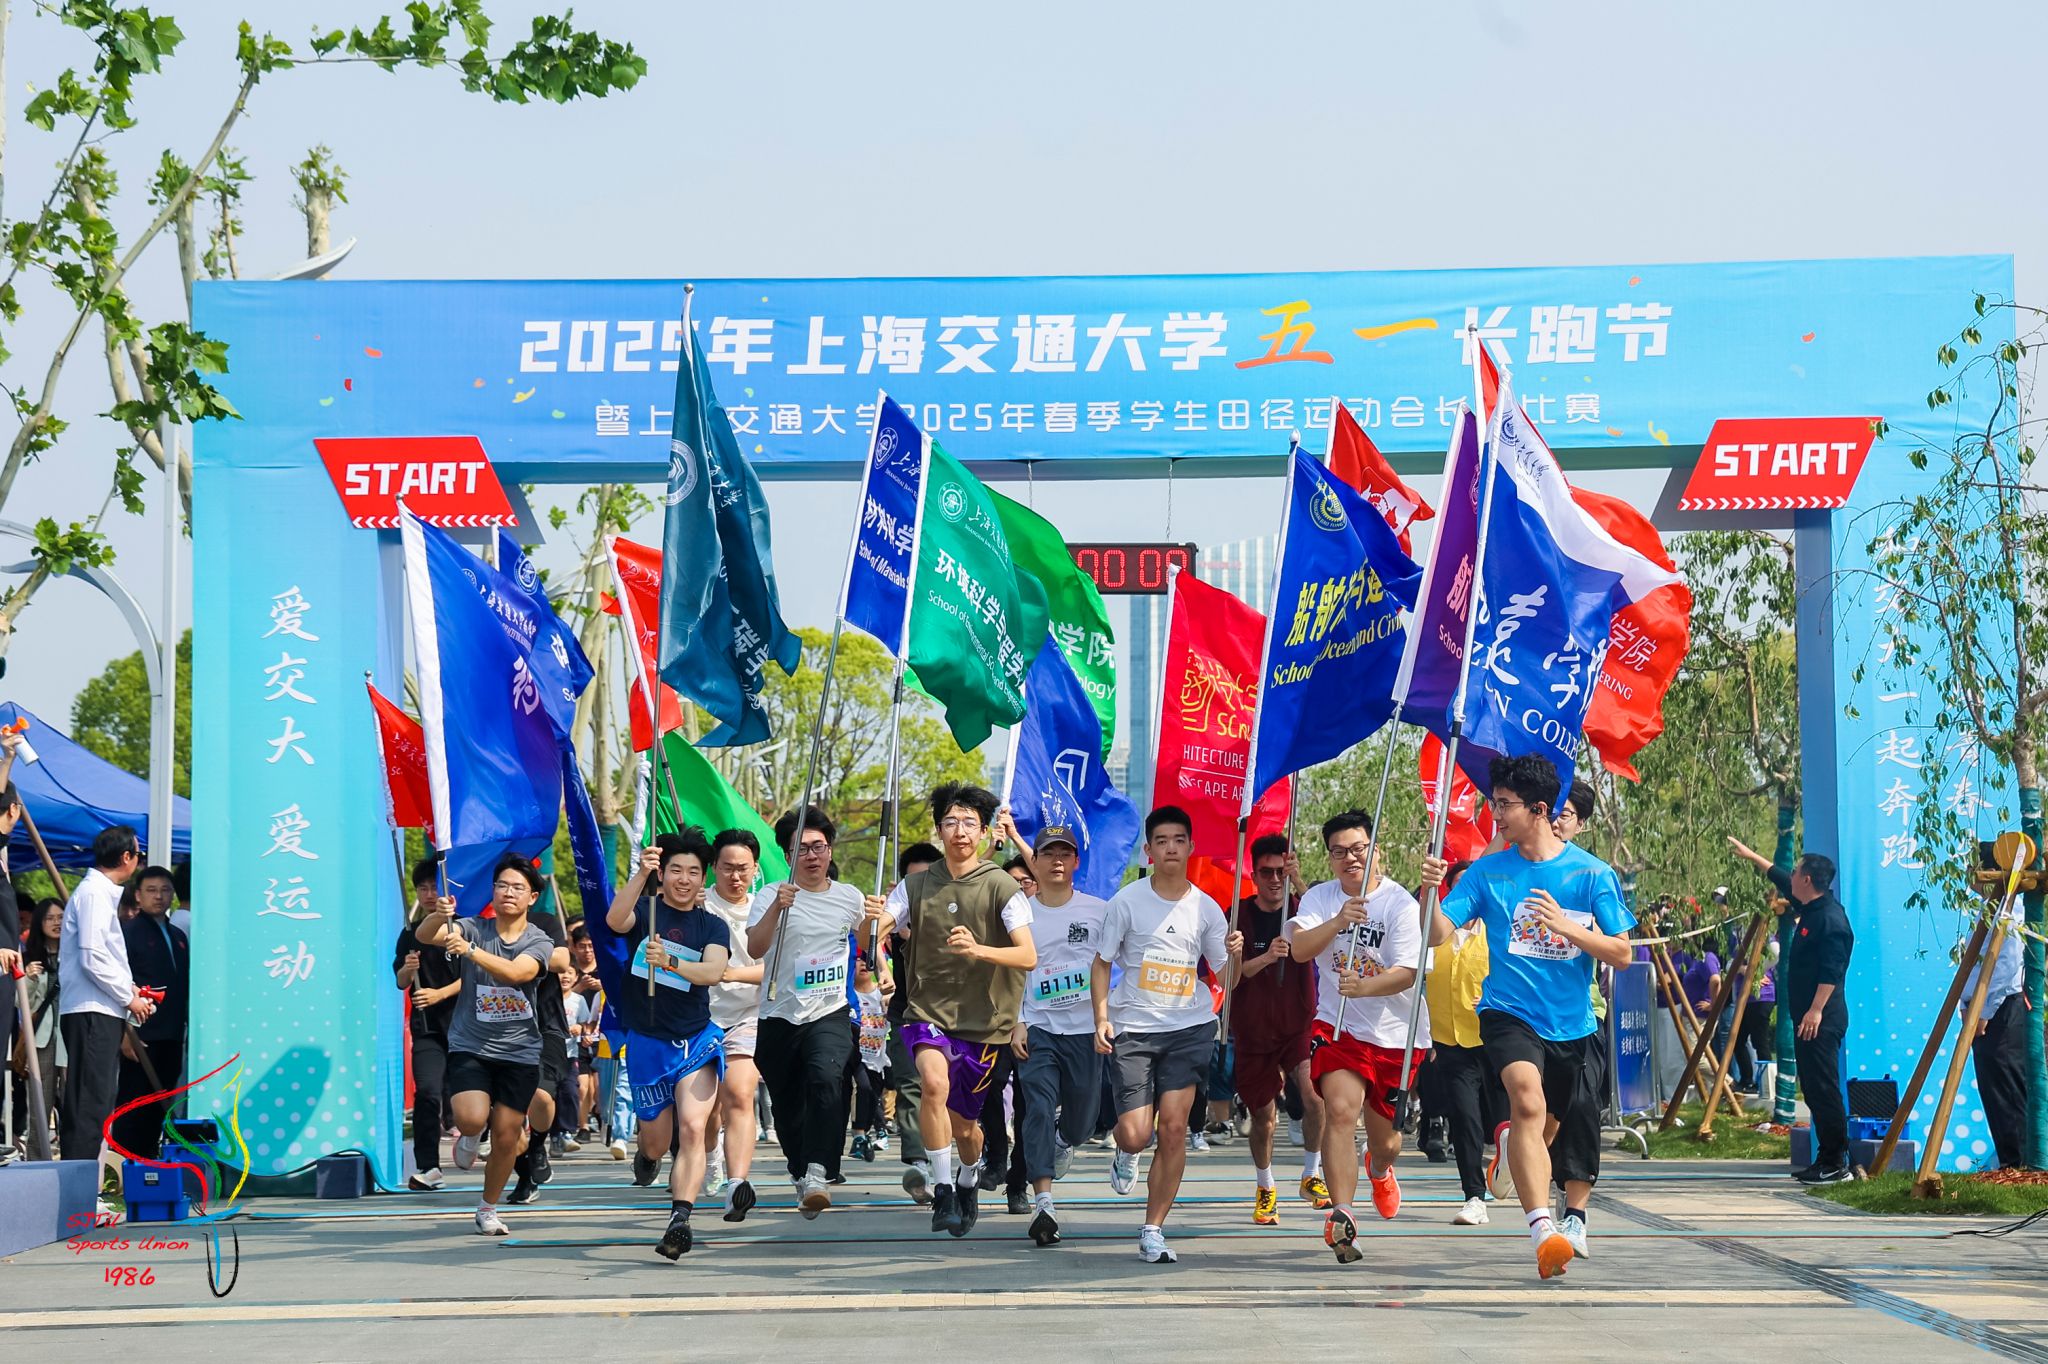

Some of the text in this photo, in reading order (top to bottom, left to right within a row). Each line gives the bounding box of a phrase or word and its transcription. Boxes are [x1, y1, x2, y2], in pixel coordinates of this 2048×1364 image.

[595, 393, 1601, 437] 暨上交通大学025年春季学生田径运动会长比赛
[1714, 441, 1858, 477] START
[345, 461, 486, 496] START
[927, 589, 958, 617] School
[1439, 624, 1464, 660] Schoo
[1271, 660, 1315, 690] Schoo
[256, 585, 323, 990] 爱交大 爱运动
[803, 965, 844, 985] B030
[1040, 972, 1085, 996] B114
[1146, 967, 1191, 987] B060
